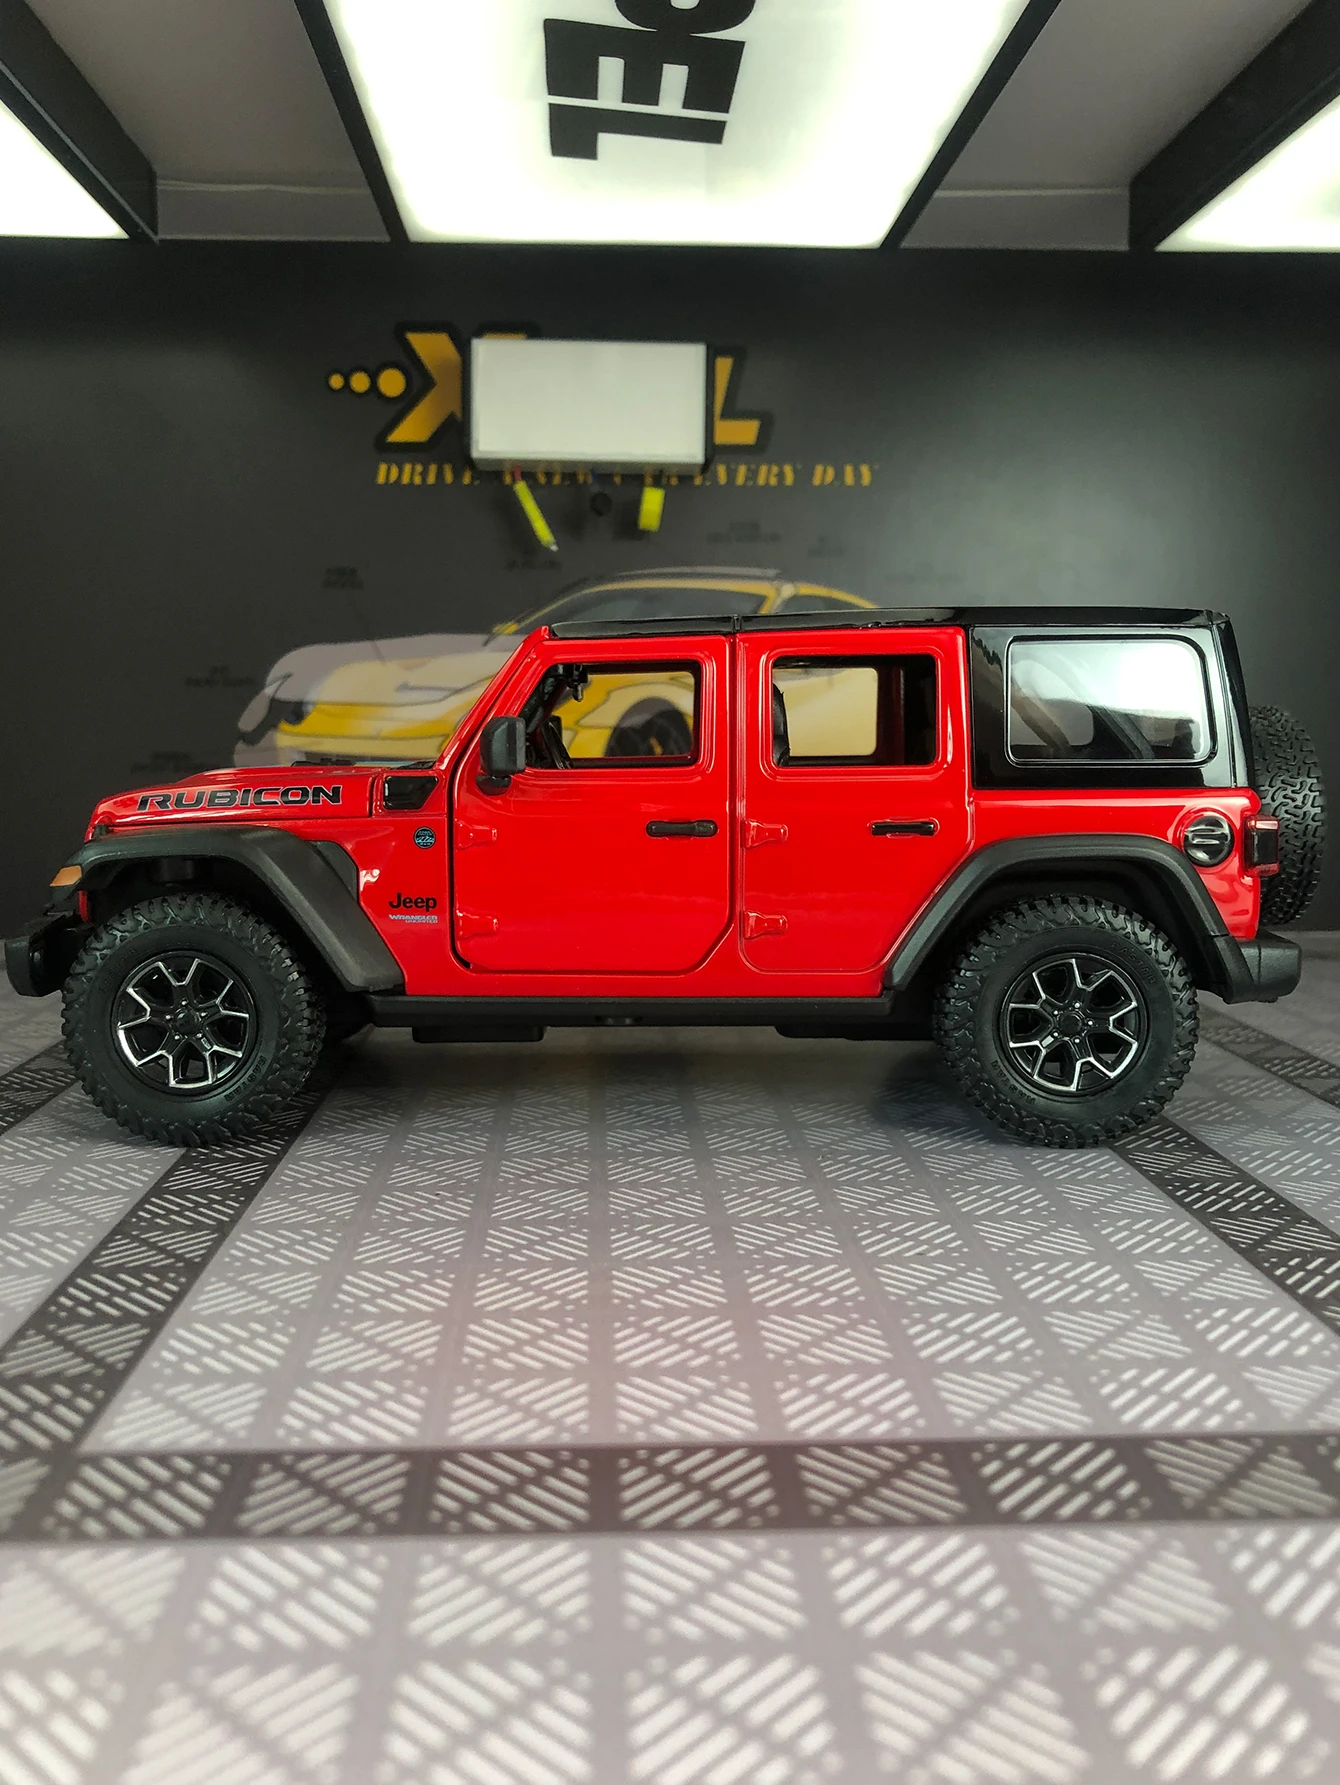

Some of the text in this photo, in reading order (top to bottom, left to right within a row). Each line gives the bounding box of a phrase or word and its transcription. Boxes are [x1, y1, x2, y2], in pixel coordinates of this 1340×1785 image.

[812, 463, 880, 487] DAY
[137, 785, 342, 811] RUBICON
[388, 892, 438, 912] Jeep
